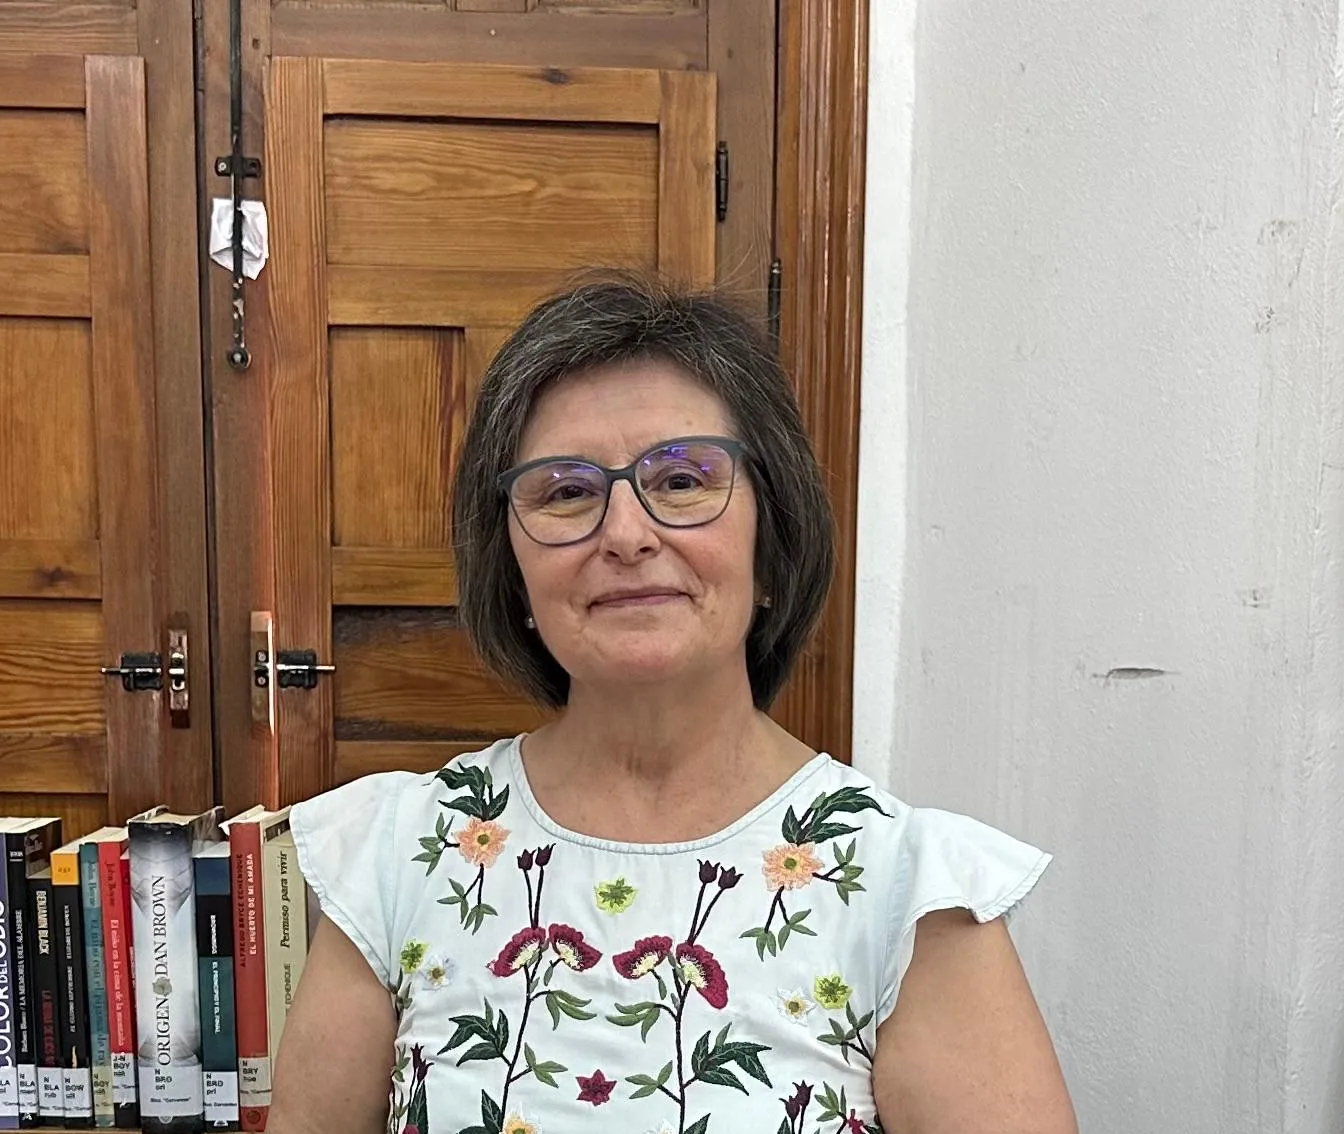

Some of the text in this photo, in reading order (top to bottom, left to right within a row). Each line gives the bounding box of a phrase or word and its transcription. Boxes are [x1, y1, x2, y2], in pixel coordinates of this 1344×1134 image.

[152, 876, 167, 976] DAN BROWN
[157, 997, 172, 1066] ORIGEN
